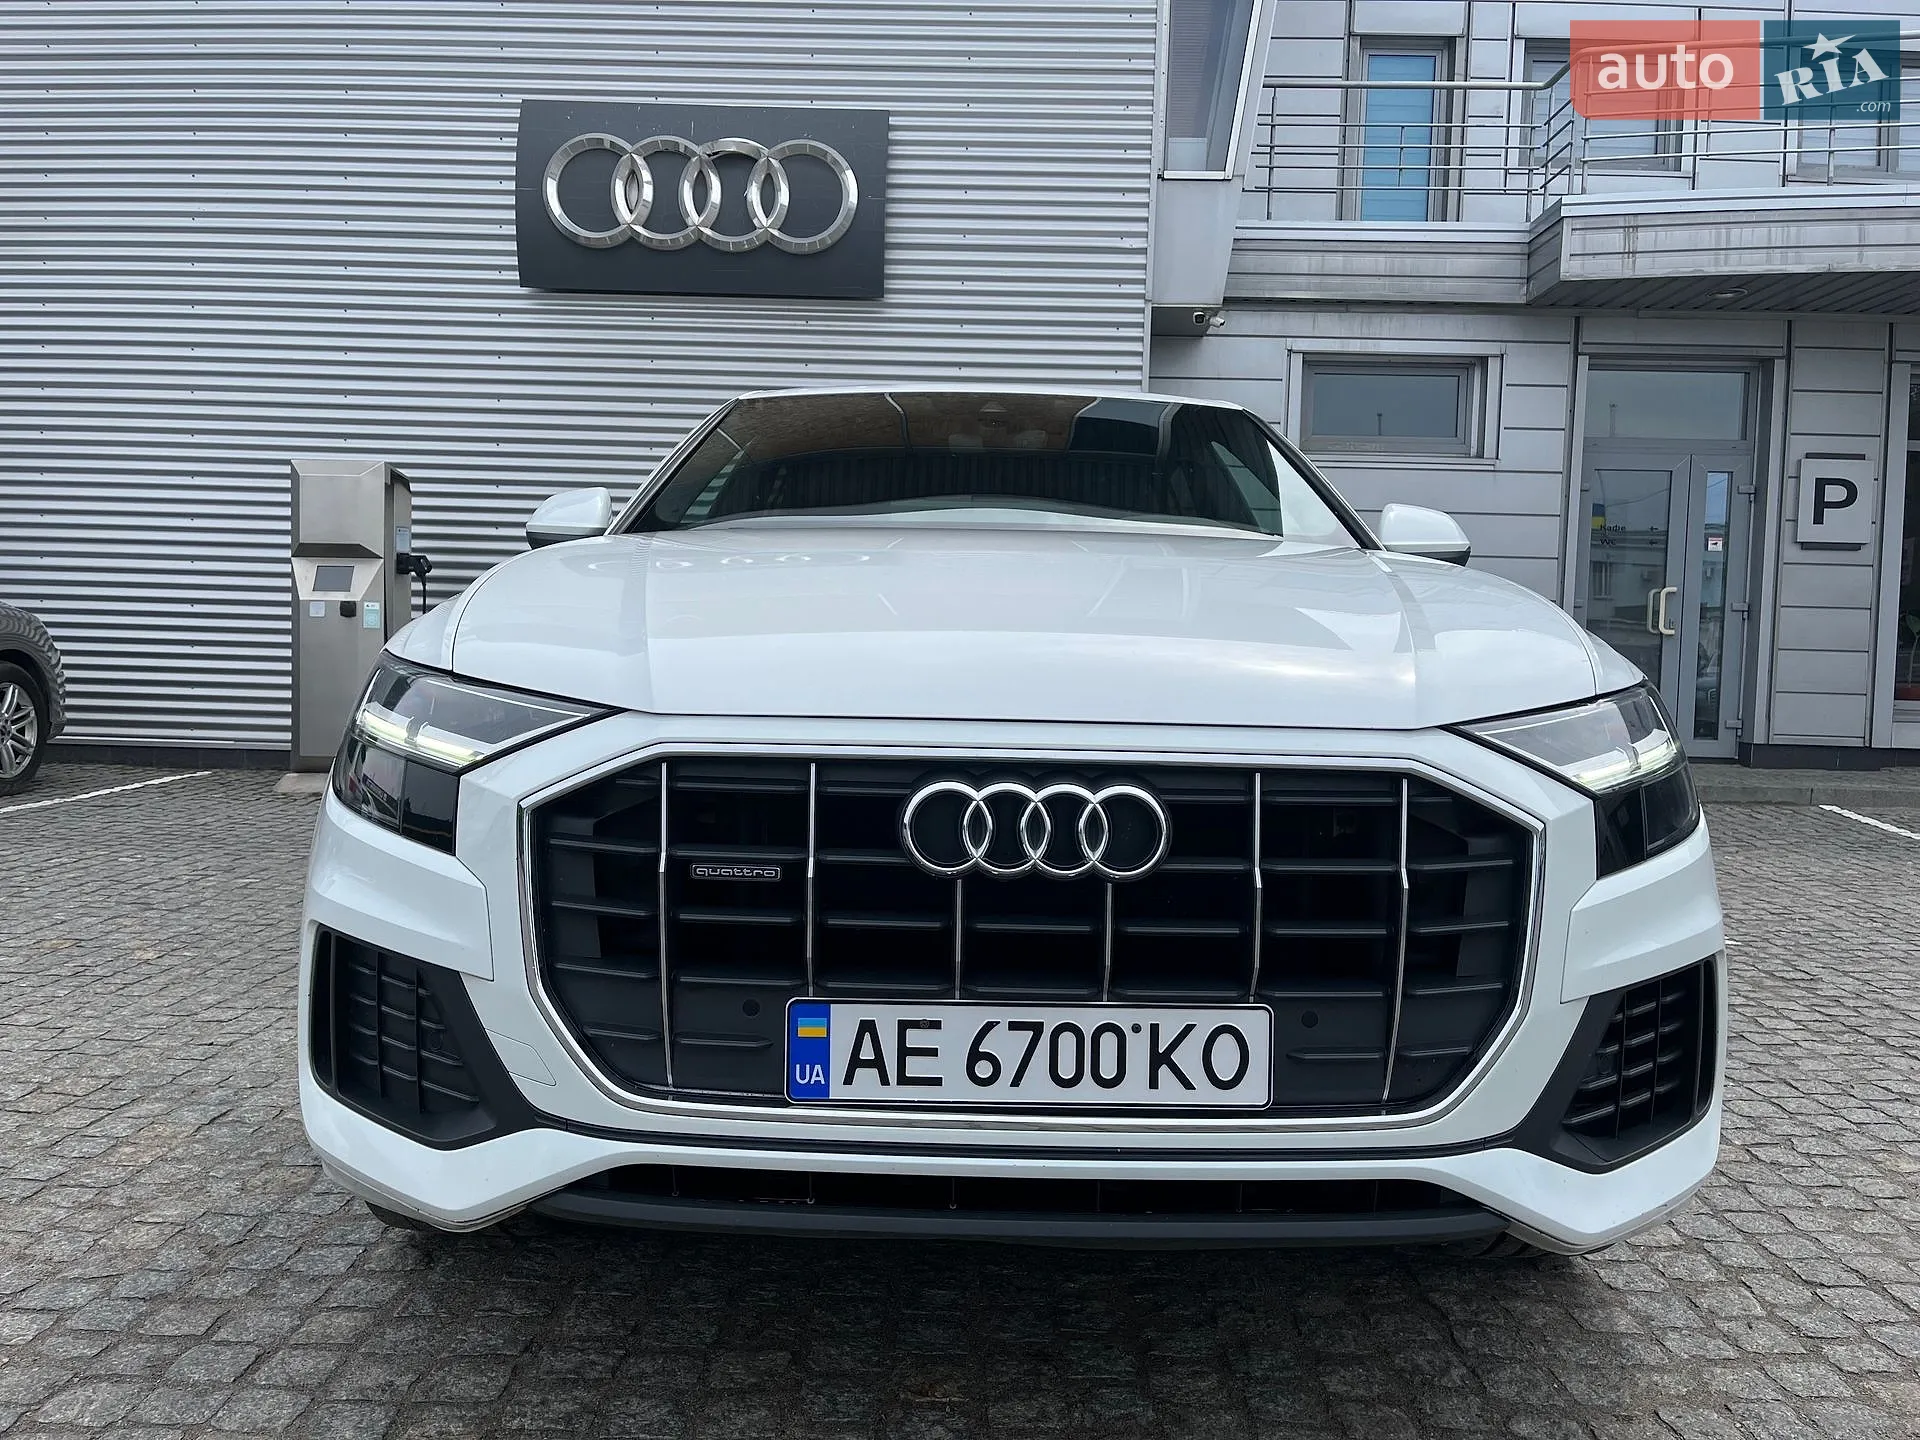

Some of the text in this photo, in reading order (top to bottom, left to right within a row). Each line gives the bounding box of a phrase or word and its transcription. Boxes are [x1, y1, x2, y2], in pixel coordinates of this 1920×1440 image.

[1812, 477, 1858, 525] P
[696, 867, 776, 877] quattro
[841, 1018, 1251, 1092] AE 6700 KO
[795, 1064, 826, 1086] UA
